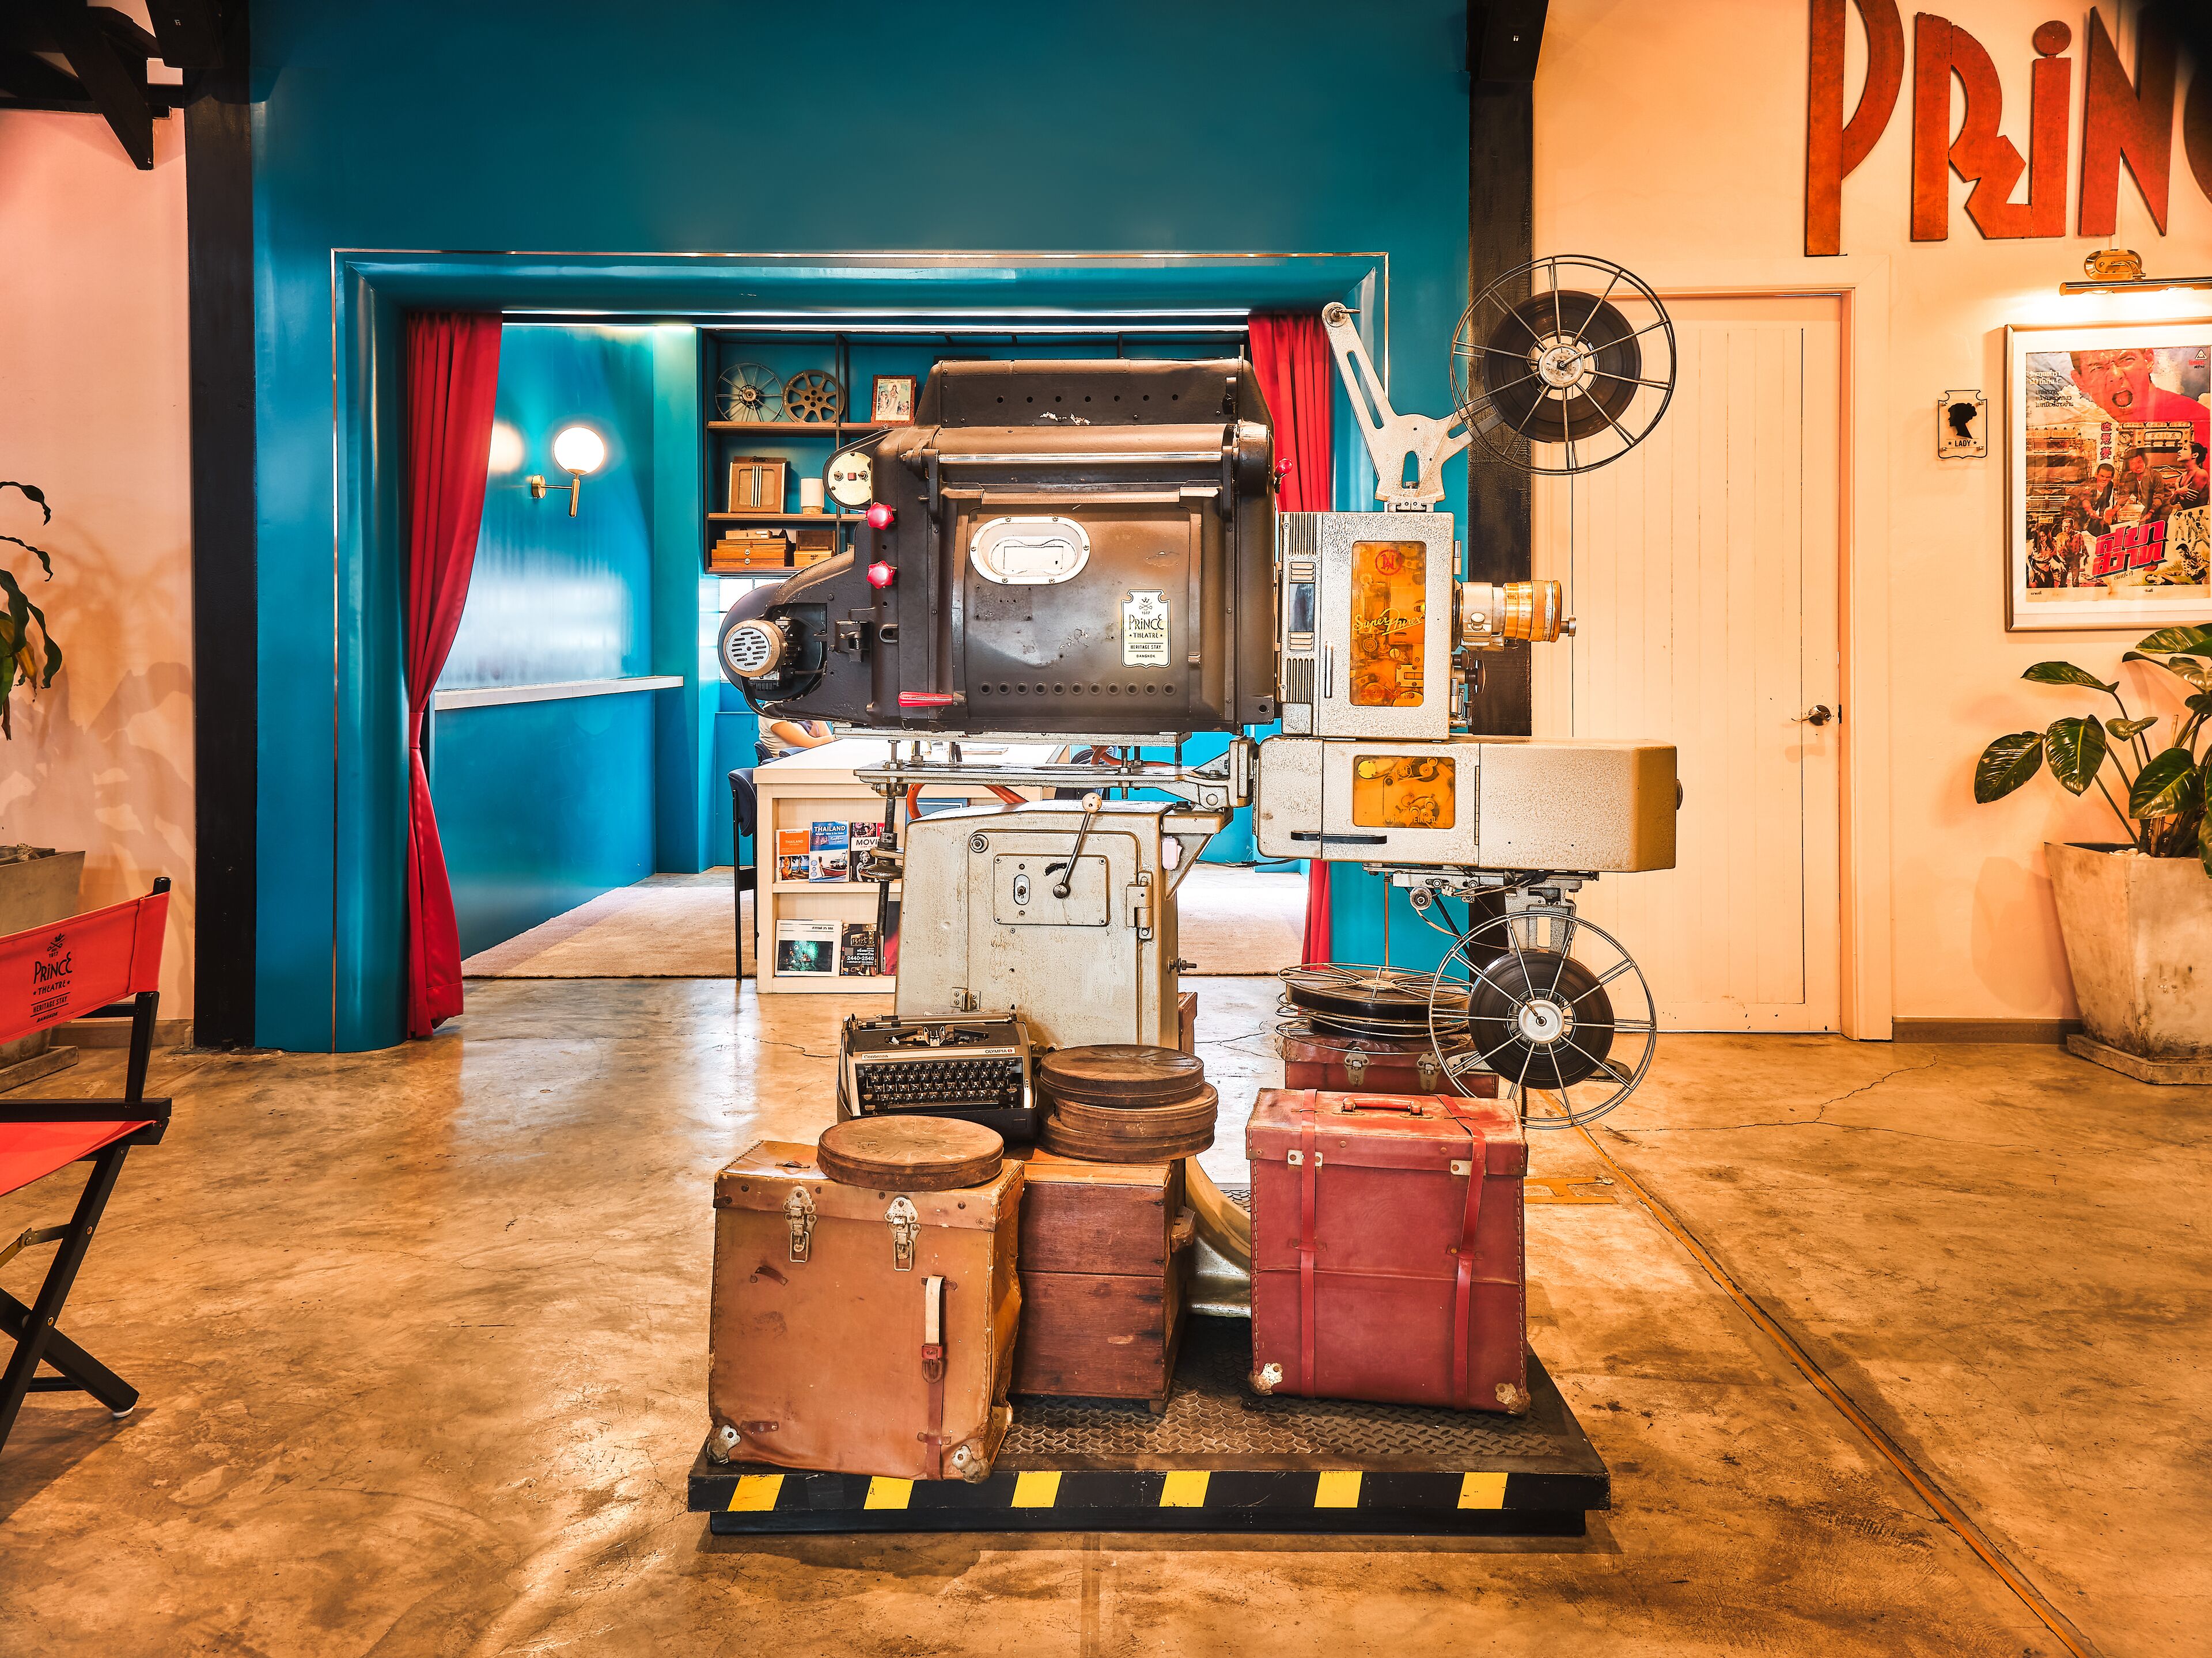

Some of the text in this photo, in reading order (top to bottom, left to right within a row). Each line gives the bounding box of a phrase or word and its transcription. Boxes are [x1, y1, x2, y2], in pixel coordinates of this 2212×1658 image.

[1352, 614, 1388, 633] Super
[38, 980, 66, 995] THEATRE
[33, 996, 67, 1013] HERITAGE STAY
[37, 1012, 58, 1023] BANGKOK
